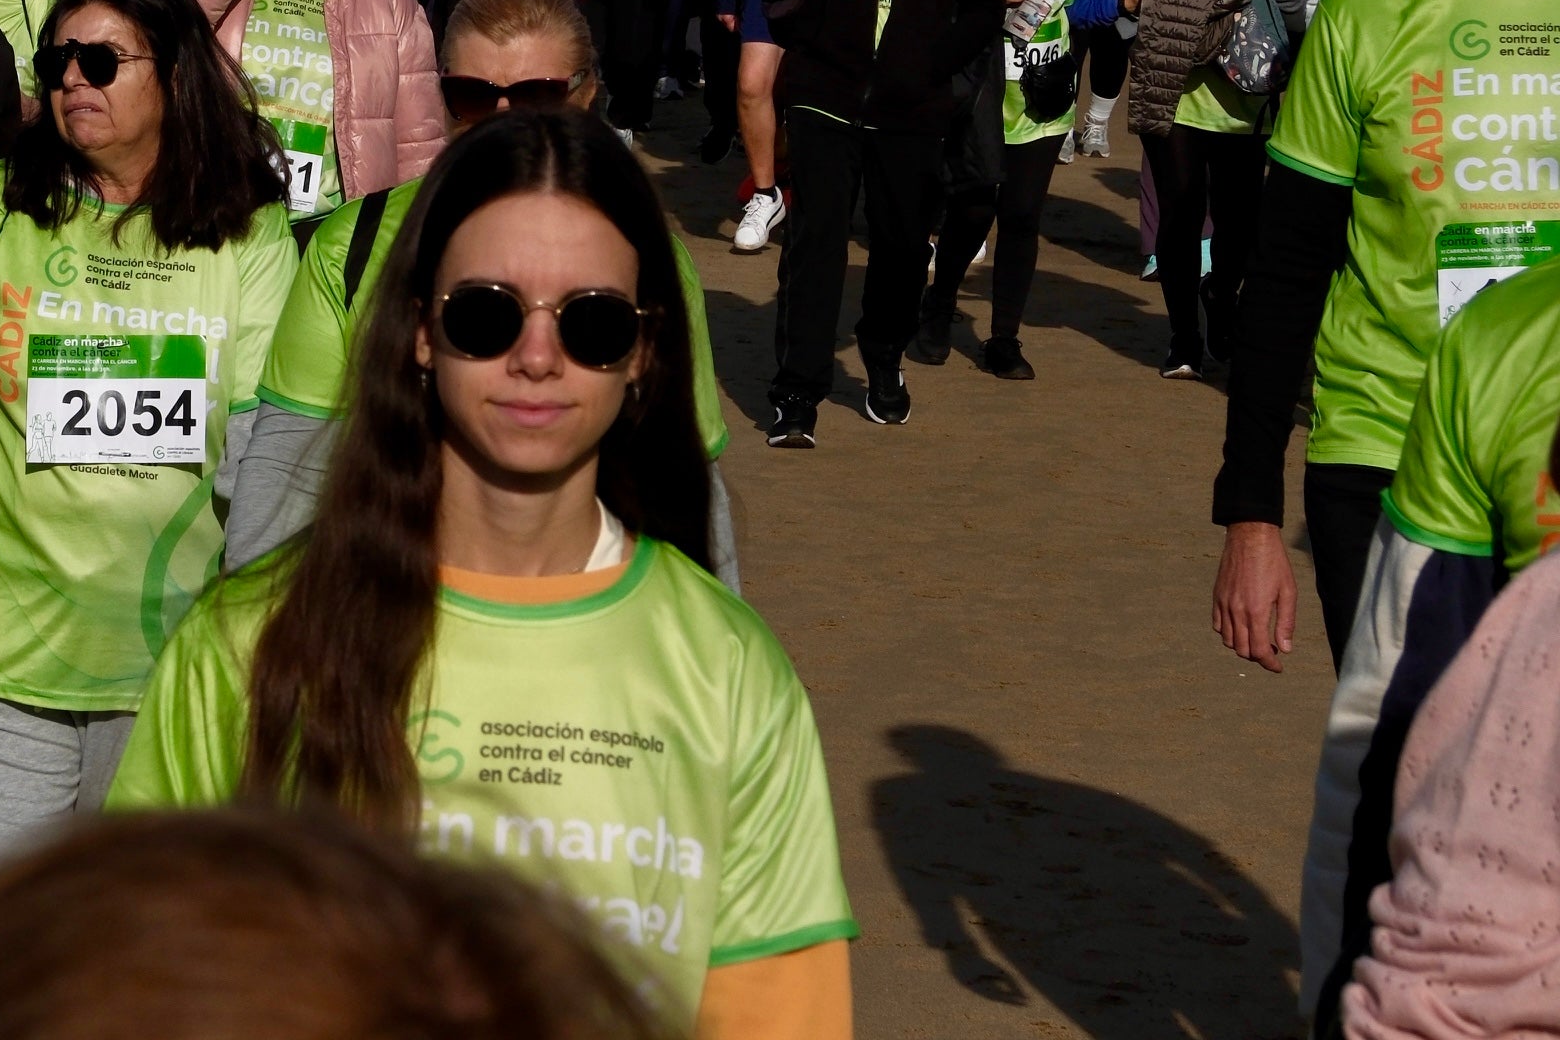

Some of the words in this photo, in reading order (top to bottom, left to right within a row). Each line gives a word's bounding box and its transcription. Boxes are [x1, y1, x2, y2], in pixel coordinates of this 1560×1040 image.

[283, 7, 305, 18] Cádiz
[245, 15, 270, 34] En
[277, 22, 328, 44] mar
[1499, 35, 1537, 44] contra
[1539, 33, 1550, 44] el
[1013, 43, 1059, 68] 5046
[1500, 48, 1515, 56] en
[1517, 45, 1550, 57] Cádiz
[1452, 68, 1499, 96] En
[1402, 70, 1444, 192] CÁDIZ
[1451, 106, 1560, 141] cont
[1454, 146, 1560, 192] cán
[1470, 202, 1506, 210] MARCHA
[1521, 201, 1546, 210] CÁDIZ
[1474, 227, 1490, 235] en
[1493, 224, 1536, 235] marcha
[1441, 238, 1478, 247] contra
[87, 252, 144, 269] asociación
[146, 259, 196, 273] española
[85, 276, 99, 285] en
[100, 277, 131, 291] Cádiz
[86, 264, 121, 278] contra
[123, 267, 133, 279] el
[135, 269, 172, 283] cáncer
[37, 290, 82, 322] En
[92, 299, 227, 340] marcha
[32, 336, 61, 346] Cádiz
[64, 338, 78, 346] en
[81, 337, 123, 347] marcha
[32, 348, 67, 356] contra
[70, 347, 80, 356] el
[83, 347, 122, 357] cáncer
[60, 389, 197, 437] 2054
[69, 464, 127, 477] Guadalete
[128, 467, 158, 481] Motor
[480, 720, 584, 741] asociación
[590, 730, 665, 755] española
[480, 743, 542, 762] contra
[548, 745, 565, 762] el
[570, 748, 634, 769] cáncer
[479, 768, 503, 783] en
[508, 766, 563, 786] Cádiz
[494, 815, 704, 880] marcha
